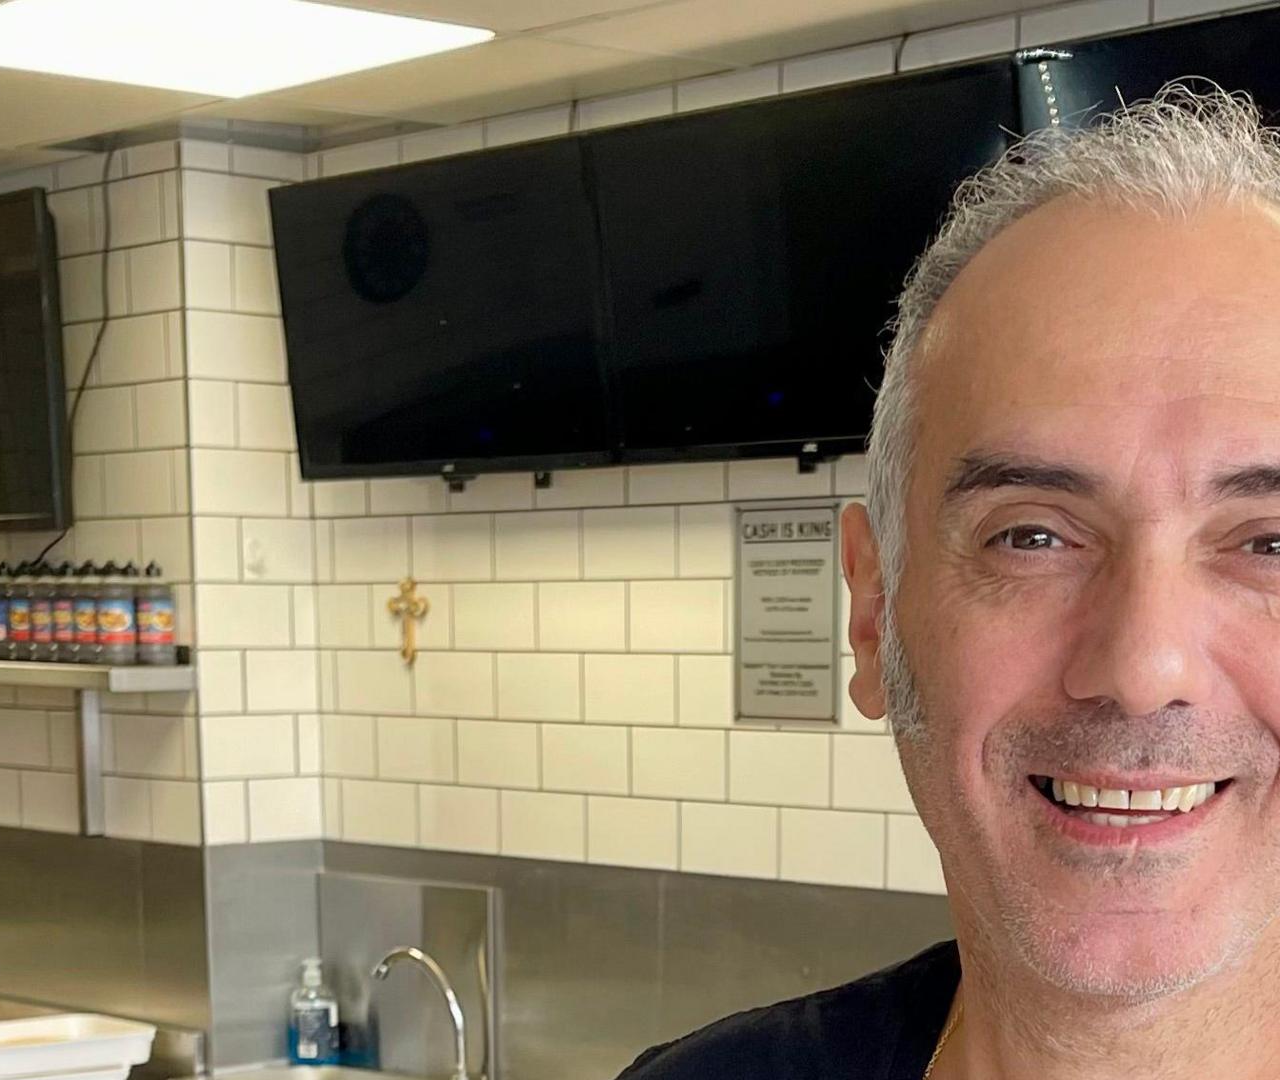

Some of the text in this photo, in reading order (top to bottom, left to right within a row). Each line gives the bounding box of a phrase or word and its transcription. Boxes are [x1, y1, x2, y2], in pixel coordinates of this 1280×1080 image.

[743, 521, 831, 539] CASH IS KING
